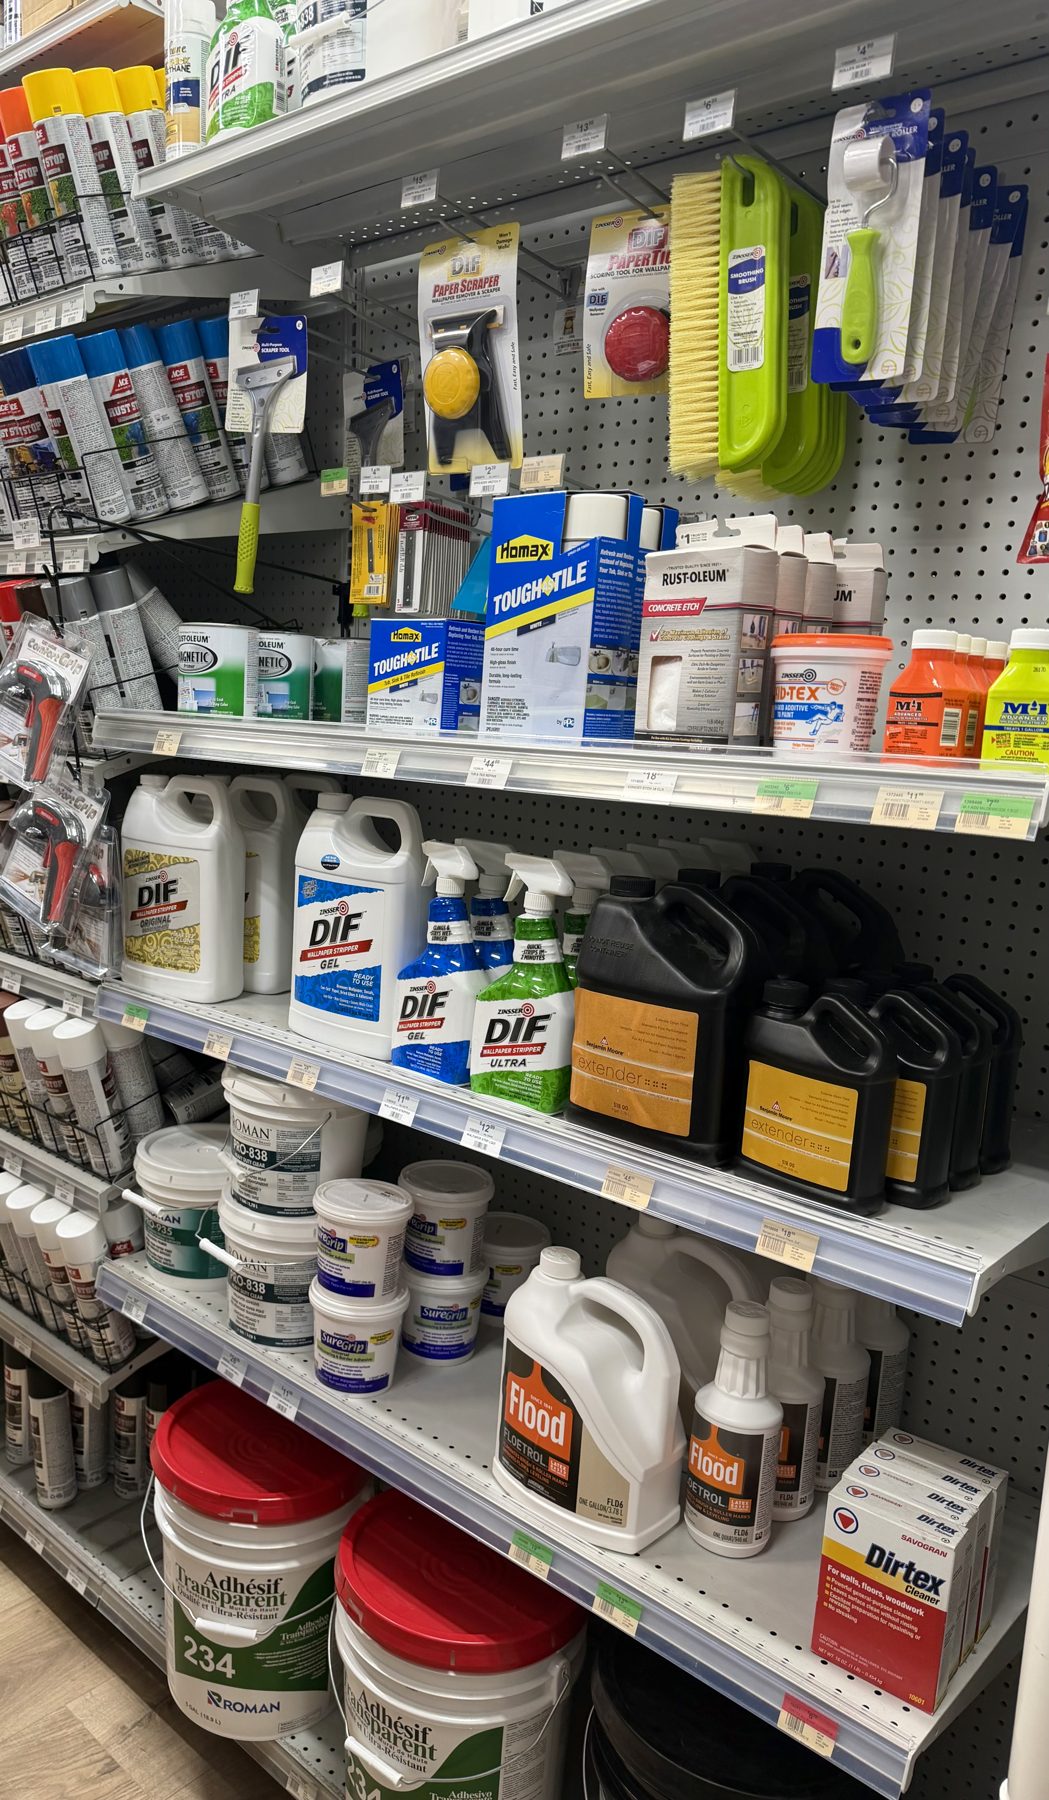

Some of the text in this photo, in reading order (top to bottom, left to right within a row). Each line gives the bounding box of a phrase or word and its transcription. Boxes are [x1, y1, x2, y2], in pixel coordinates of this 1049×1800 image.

[45, 153, 65, 171] STOP
[595, 221, 614, 229] ZINSSER
[631, 228, 665, 248] DIF
[732, 252, 753, 260] ZINSSER
[451, 255, 481, 276] DIF
[730, 268, 764, 279] SMOOTHING
[590, 271, 615, 279] SCORING
[432, 275, 500, 298] PAPER SCRAPER
[432, 295, 455, 303] WALLPAPER
[456, 291, 476, 299] REMOVER
[482, 287, 501, 295] SCRAPER
[589, 294, 607, 305] DIF
[171, 368, 185, 378] ACE
[118, 378, 128, 387] ACE
[185, 389, 206, 401] STOP
[107, 403, 131, 418] RUST
[500, 539, 551, 562] Homax
[662, 568, 727, 587] RUST-OLEUM
[493, 560, 588, 615] TOUGH TILE
[648, 603, 700, 612] CONCRETE ETCH
[529, 620, 543, 630] WHITE
[393, 629, 420, 642] Homax
[374, 653, 408, 677] TOUGH
[416, 643, 439, 662] TILE
[411, 669, 426, 678] Refinish
[1005, 749, 1035, 757] CAUTION
[138, 880, 178, 908] DIF
[136, 904, 178, 918] WALLPAPER STRIPPER
[319, 906, 339, 915] ZINSSER
[140, 915, 172, 927] ORIGINAL
[309, 912, 363, 947] DIF
[307, 945, 359, 959] WALLPAPER STRIPPER
[320, 959, 340, 970] GEL
[354, 972, 375, 981] READY
[400, 991, 449, 1019] DIF
[498, 1008, 523, 1016] ZINSSER
[399, 1019, 441, 1030] WALLPAPER STRIPPER
[484, 1014, 552, 1045] DIF
[407, 1032, 425, 1041] GEL
[482, 1045, 542, 1056] WALLPAPER STRIPPER
[586, 1040, 624, 1056] Benjamin Moore
[490, 1059, 527, 1068] ULTRA
[578, 1055, 643, 1085] extender
[759, 1105, 793, 1122] Benjamin Moore
[751, 1118, 809, 1147] extender
[250, 1292, 264, 1300] CLEAR
[422, 1307, 467, 1322] SureGrip
[321, 1333, 365, 1353] SureGrip
[530, 1394, 543, 1406] SINCE
[508, 1380, 566, 1446] Flood
[503, 1427, 546, 1467] FLOETROL
[690, 1441, 739, 1486] Flood
[960, 1458, 999, 1478] Dirtex
[942, 1475, 982, 1494] Dirtex
[579, 1496, 588, 1505] ONE
[607, 1498, 624, 1508] FLD6
[779, 1493, 794, 1501] FLD6
[927, 1492, 968, 1513] Dirtex
[707, 1511, 730, 1522] LEVELING
[713, 1507, 751, 1520] ROLLER MARKS
[734, 1529, 749, 1537] FLD6
[917, 1514, 958, 1536] Dirtex
[900, 1534, 948, 1558] SAVOGRAN
[865, 1542, 946, 1597] Dirtex
[175, 1562, 288, 1612] Transparent
[204, 1571, 283, 1595] Adhésif
[827, 1564, 925, 1617] For walls, floors, woodwork
[177, 1585, 278, 1620] Qualité et Ultra-Résistant
[831, 1577, 913, 1621] Powerful cleaner
[905, 1584, 941, 1606] Cleaner
[828, 1603, 858, 1624] No streaking
[830, 1584, 919, 1633] Leaves surface clean without rinsing
[830, 1591, 851, 1606] Excellent
[851, 1603, 880, 1621] preparation
[887, 1621, 914, 1638] repainting
[183, 1635, 235, 1679] 234
[818, 1646, 827, 1655] NET
[223, 1700, 281, 1714] ROMAN
[200, 1713, 215, 1723] (18.9
[359, 1689, 432, 1744] Adhésif
[363, 1725, 427, 1773] Ultra-Résistant
[379, 1736, 428, 1765] Mural Haute
